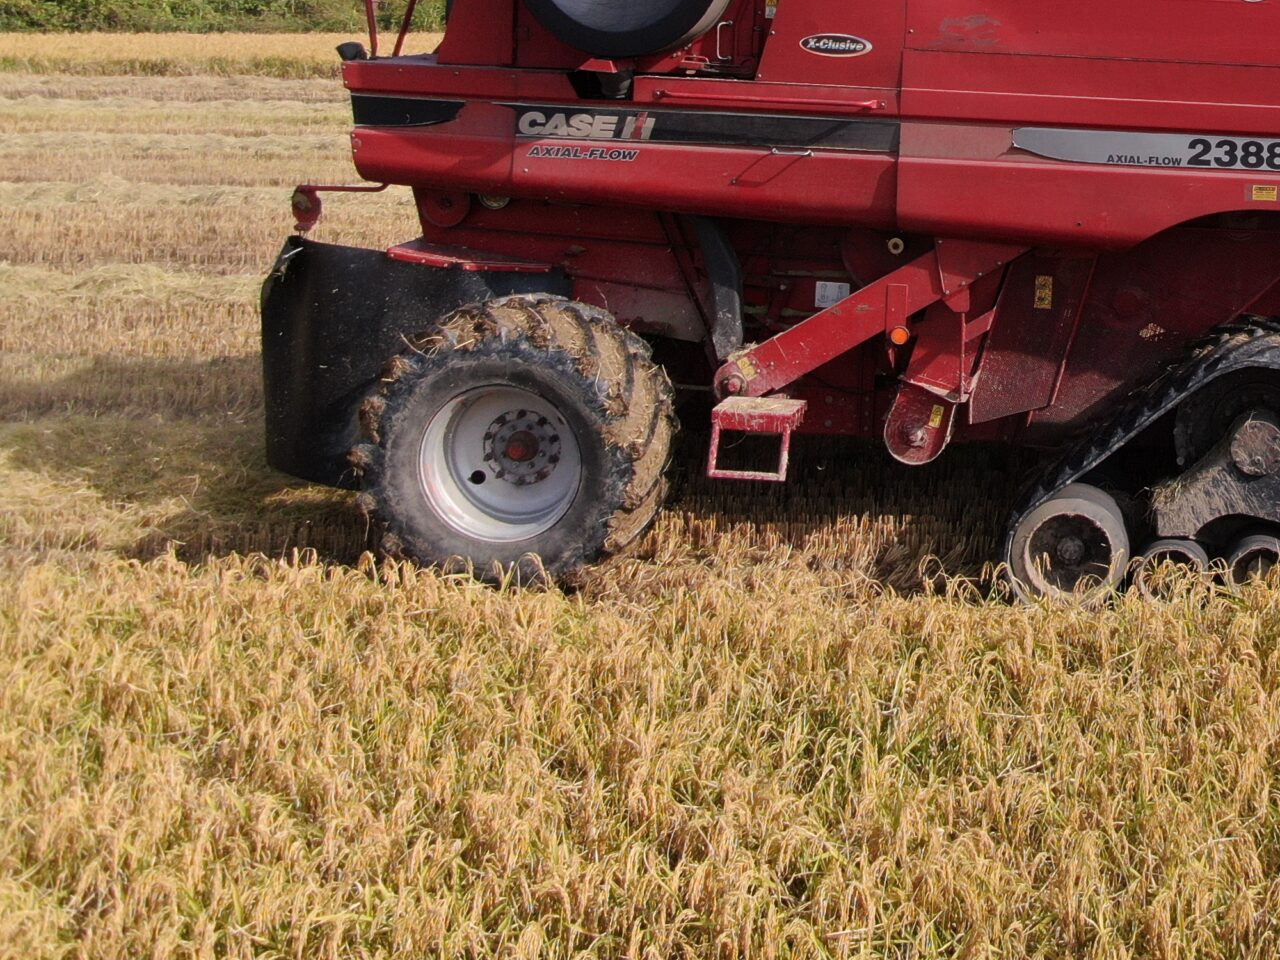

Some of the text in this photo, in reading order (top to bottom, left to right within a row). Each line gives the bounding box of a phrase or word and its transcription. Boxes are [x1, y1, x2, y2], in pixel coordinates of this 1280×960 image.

[806, 38, 864, 51] X-Clusive
[518, 111, 619, 138] CASE
[528, 145, 640, 161] AXIAL-FLOW
[1106, 154, 1182, 166] AXIAL-FLOW
